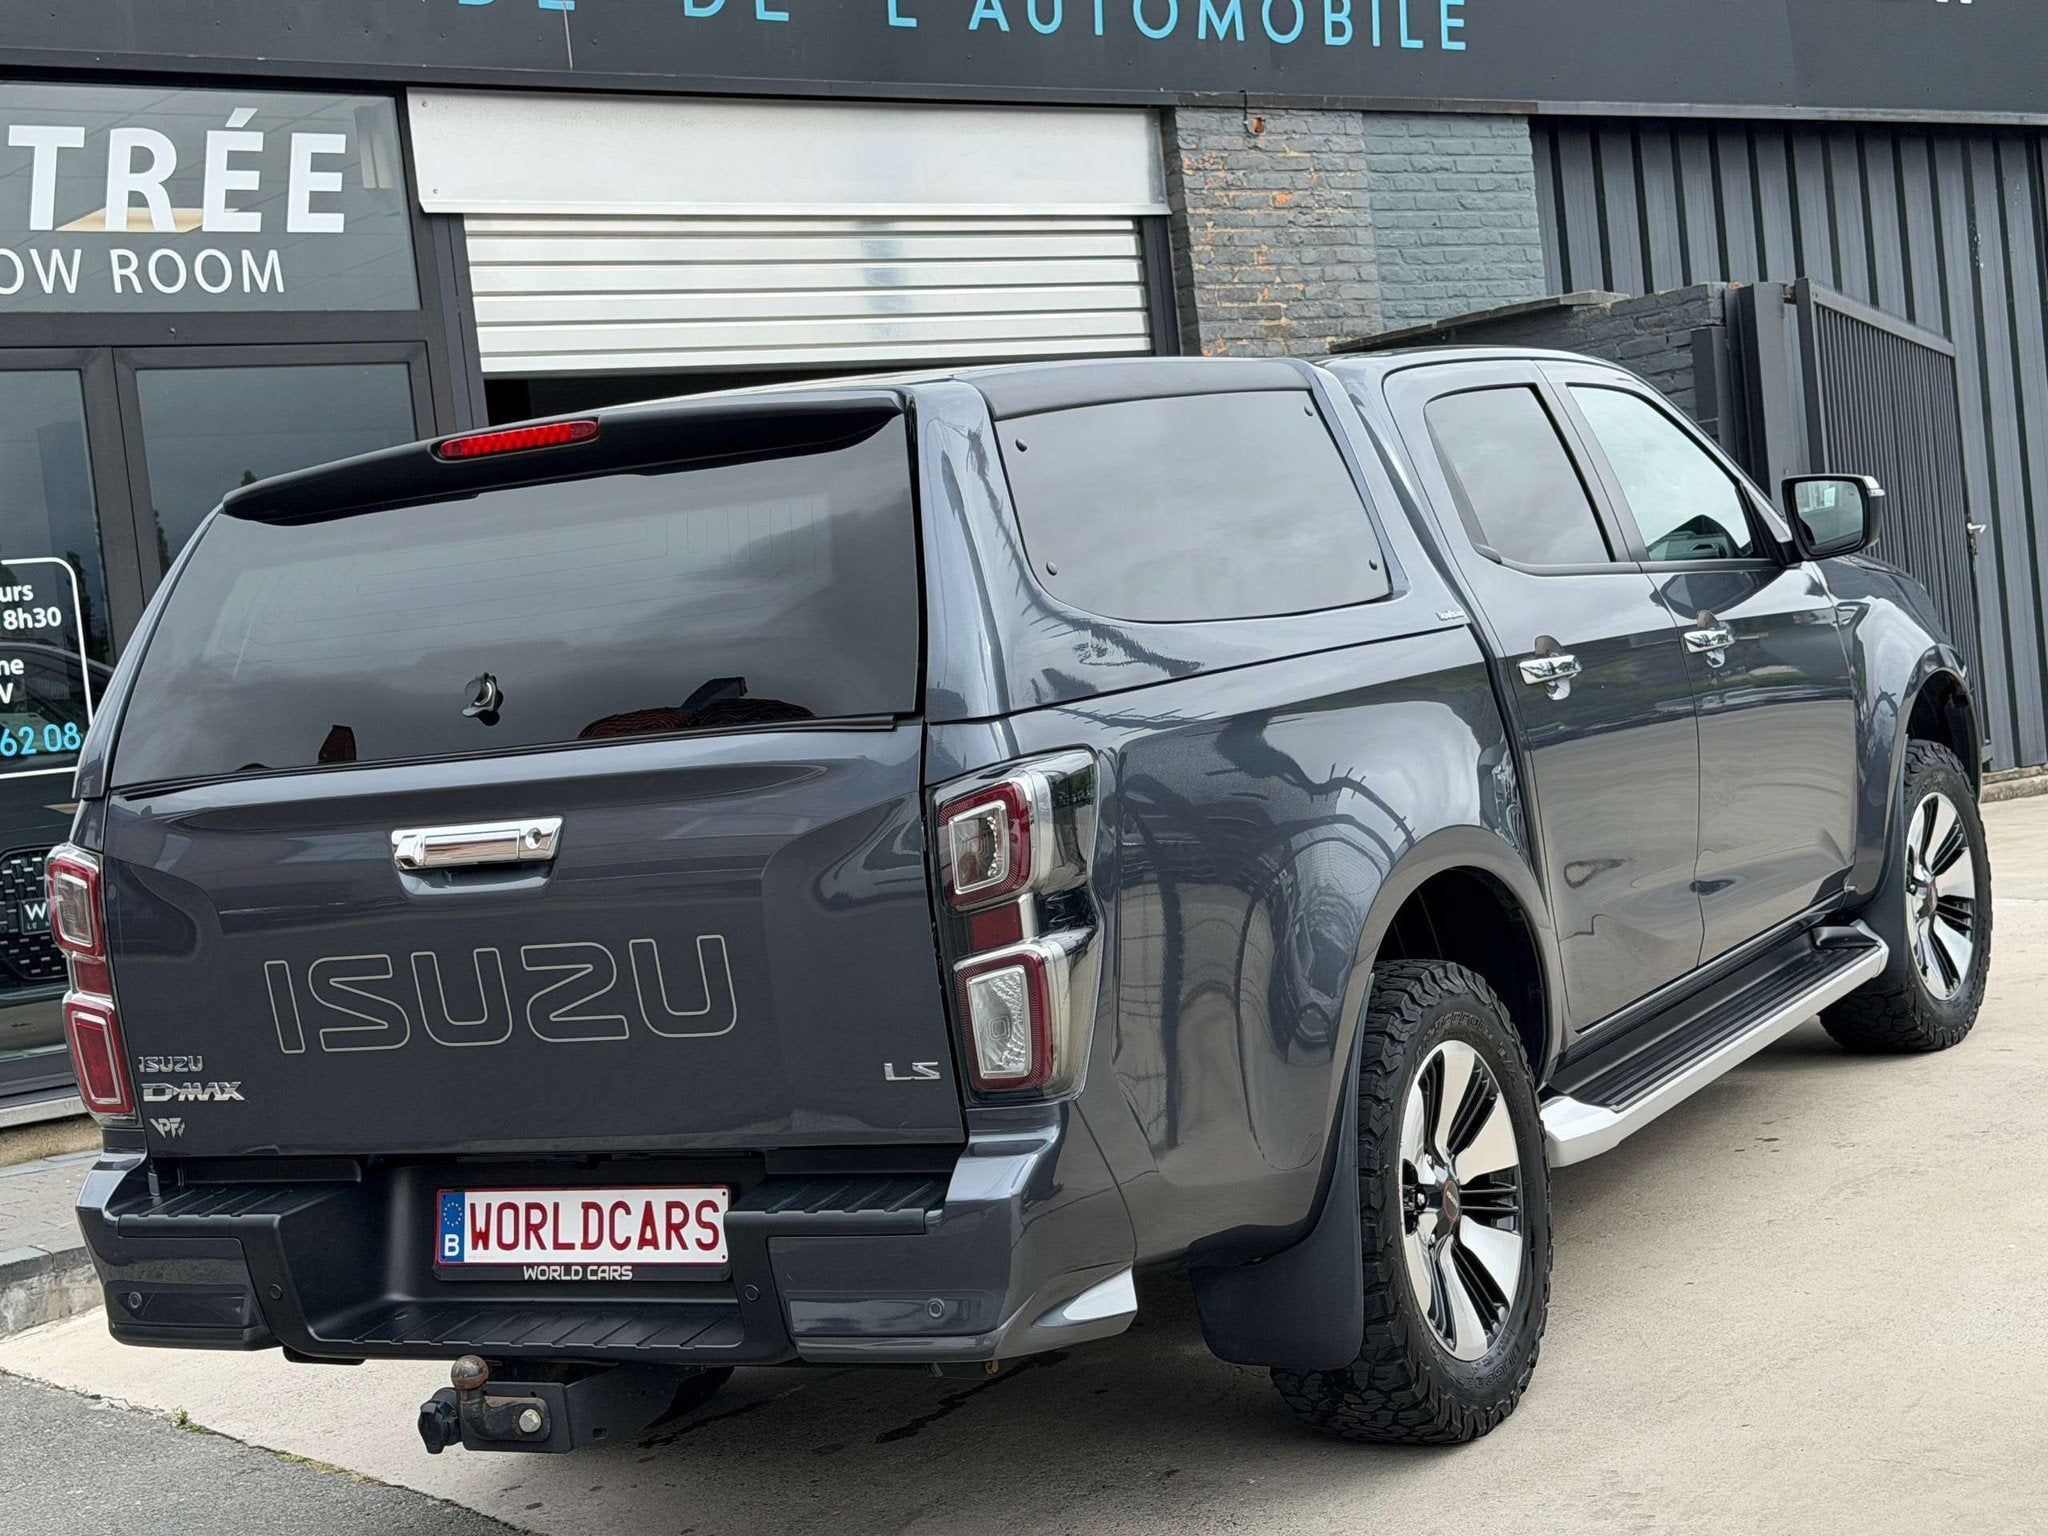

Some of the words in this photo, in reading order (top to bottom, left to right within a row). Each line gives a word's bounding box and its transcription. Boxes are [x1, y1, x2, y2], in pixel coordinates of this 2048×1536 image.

[8, 107, 347, 234] TRÉE
[111, 249, 285, 294] ROOM
[3, 606, 62, 630] 8h30
[0, 726, 37, 757] 62
[43, 721, 81, 752] 08
[264, 934, 738, 1054] ISUZU
[138, 1055, 204, 1073] ISUZU
[883, 1061, 941, 1081] LS
[469, 1200, 720, 1251] WORLDCARS
[444, 1234, 460, 1257] B
[523, 1266, 583, 1281] WORLD
[587, 1265, 633, 1281] CARS
